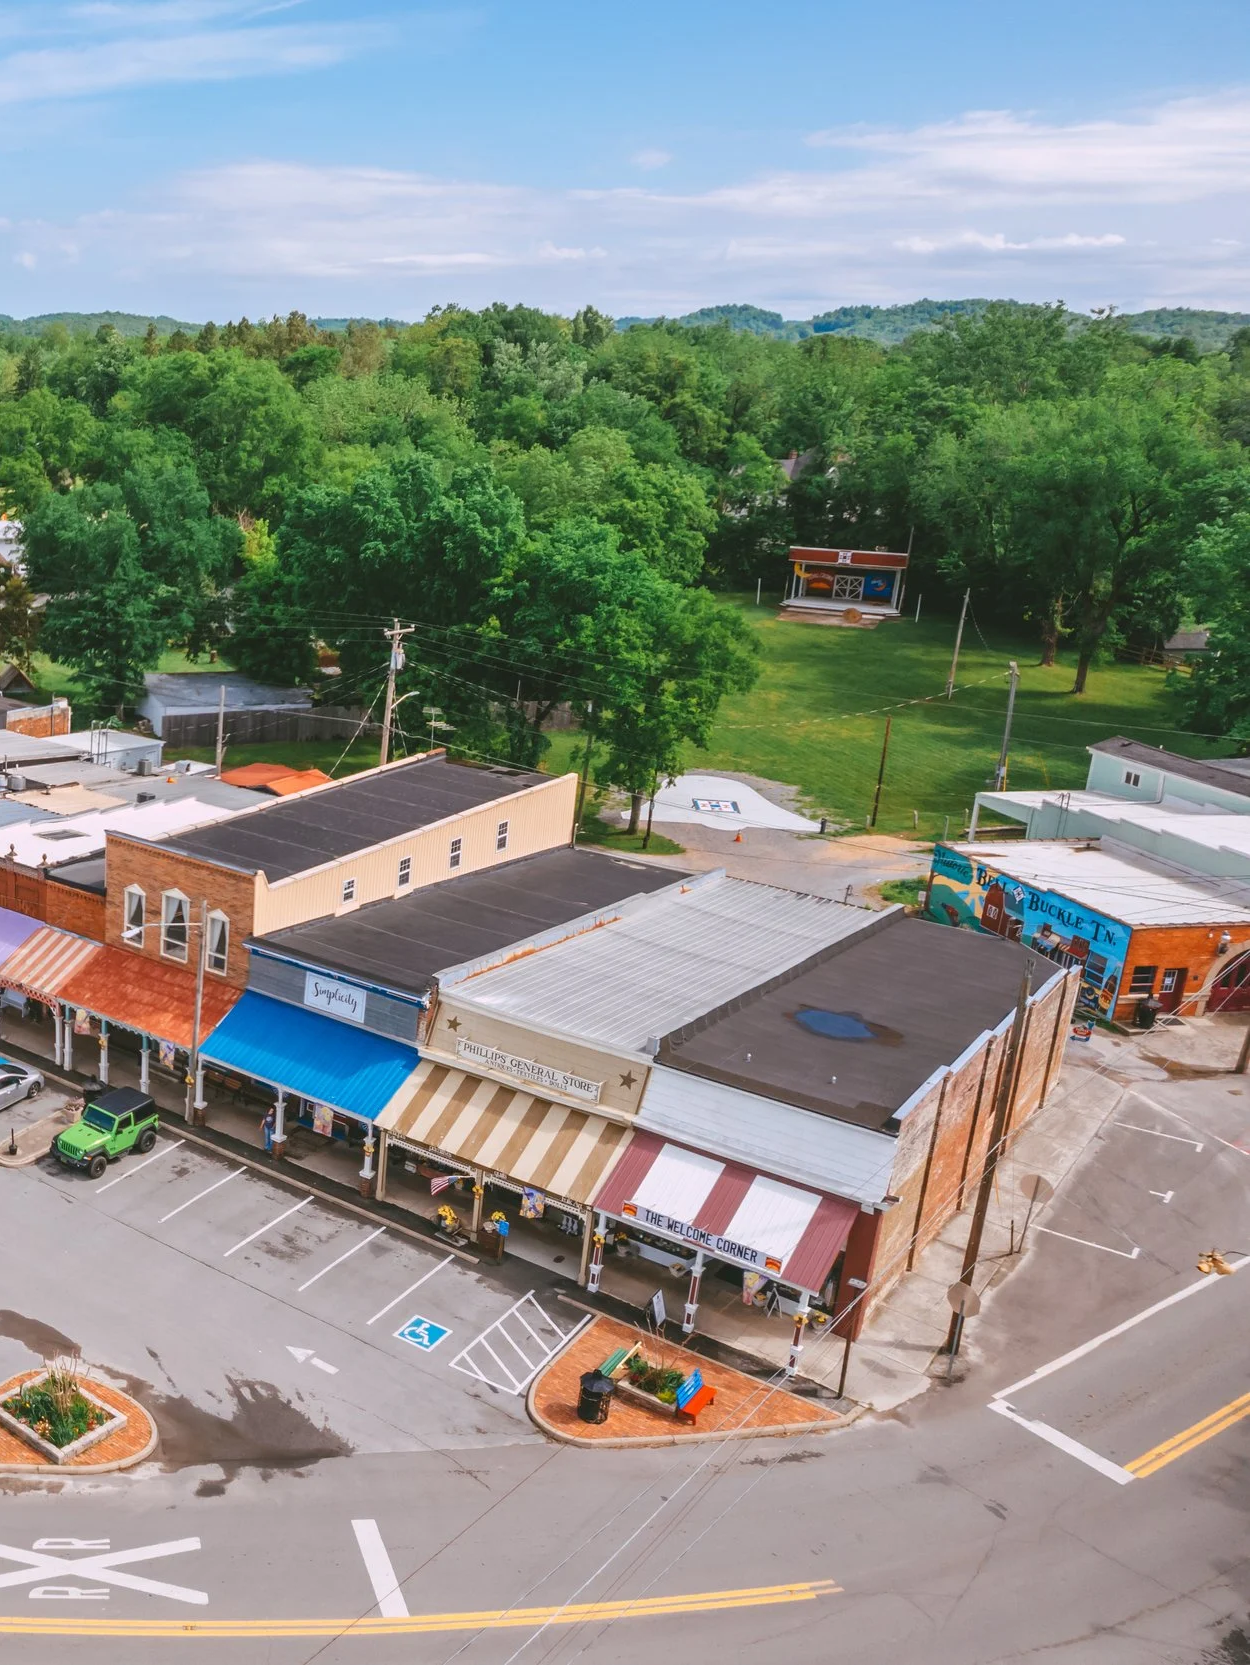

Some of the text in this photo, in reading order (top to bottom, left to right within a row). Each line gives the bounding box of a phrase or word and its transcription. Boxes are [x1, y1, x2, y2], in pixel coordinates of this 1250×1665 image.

[976, 867, 1116, 946] BELL BUCKLE TN.
[313, 982, 357, 1013] Simplicity
[464, 1042, 593, 1093] PHILLIPS GENERAL STORE
[645, 1209, 758, 1263] THE WELCOME CORNER
